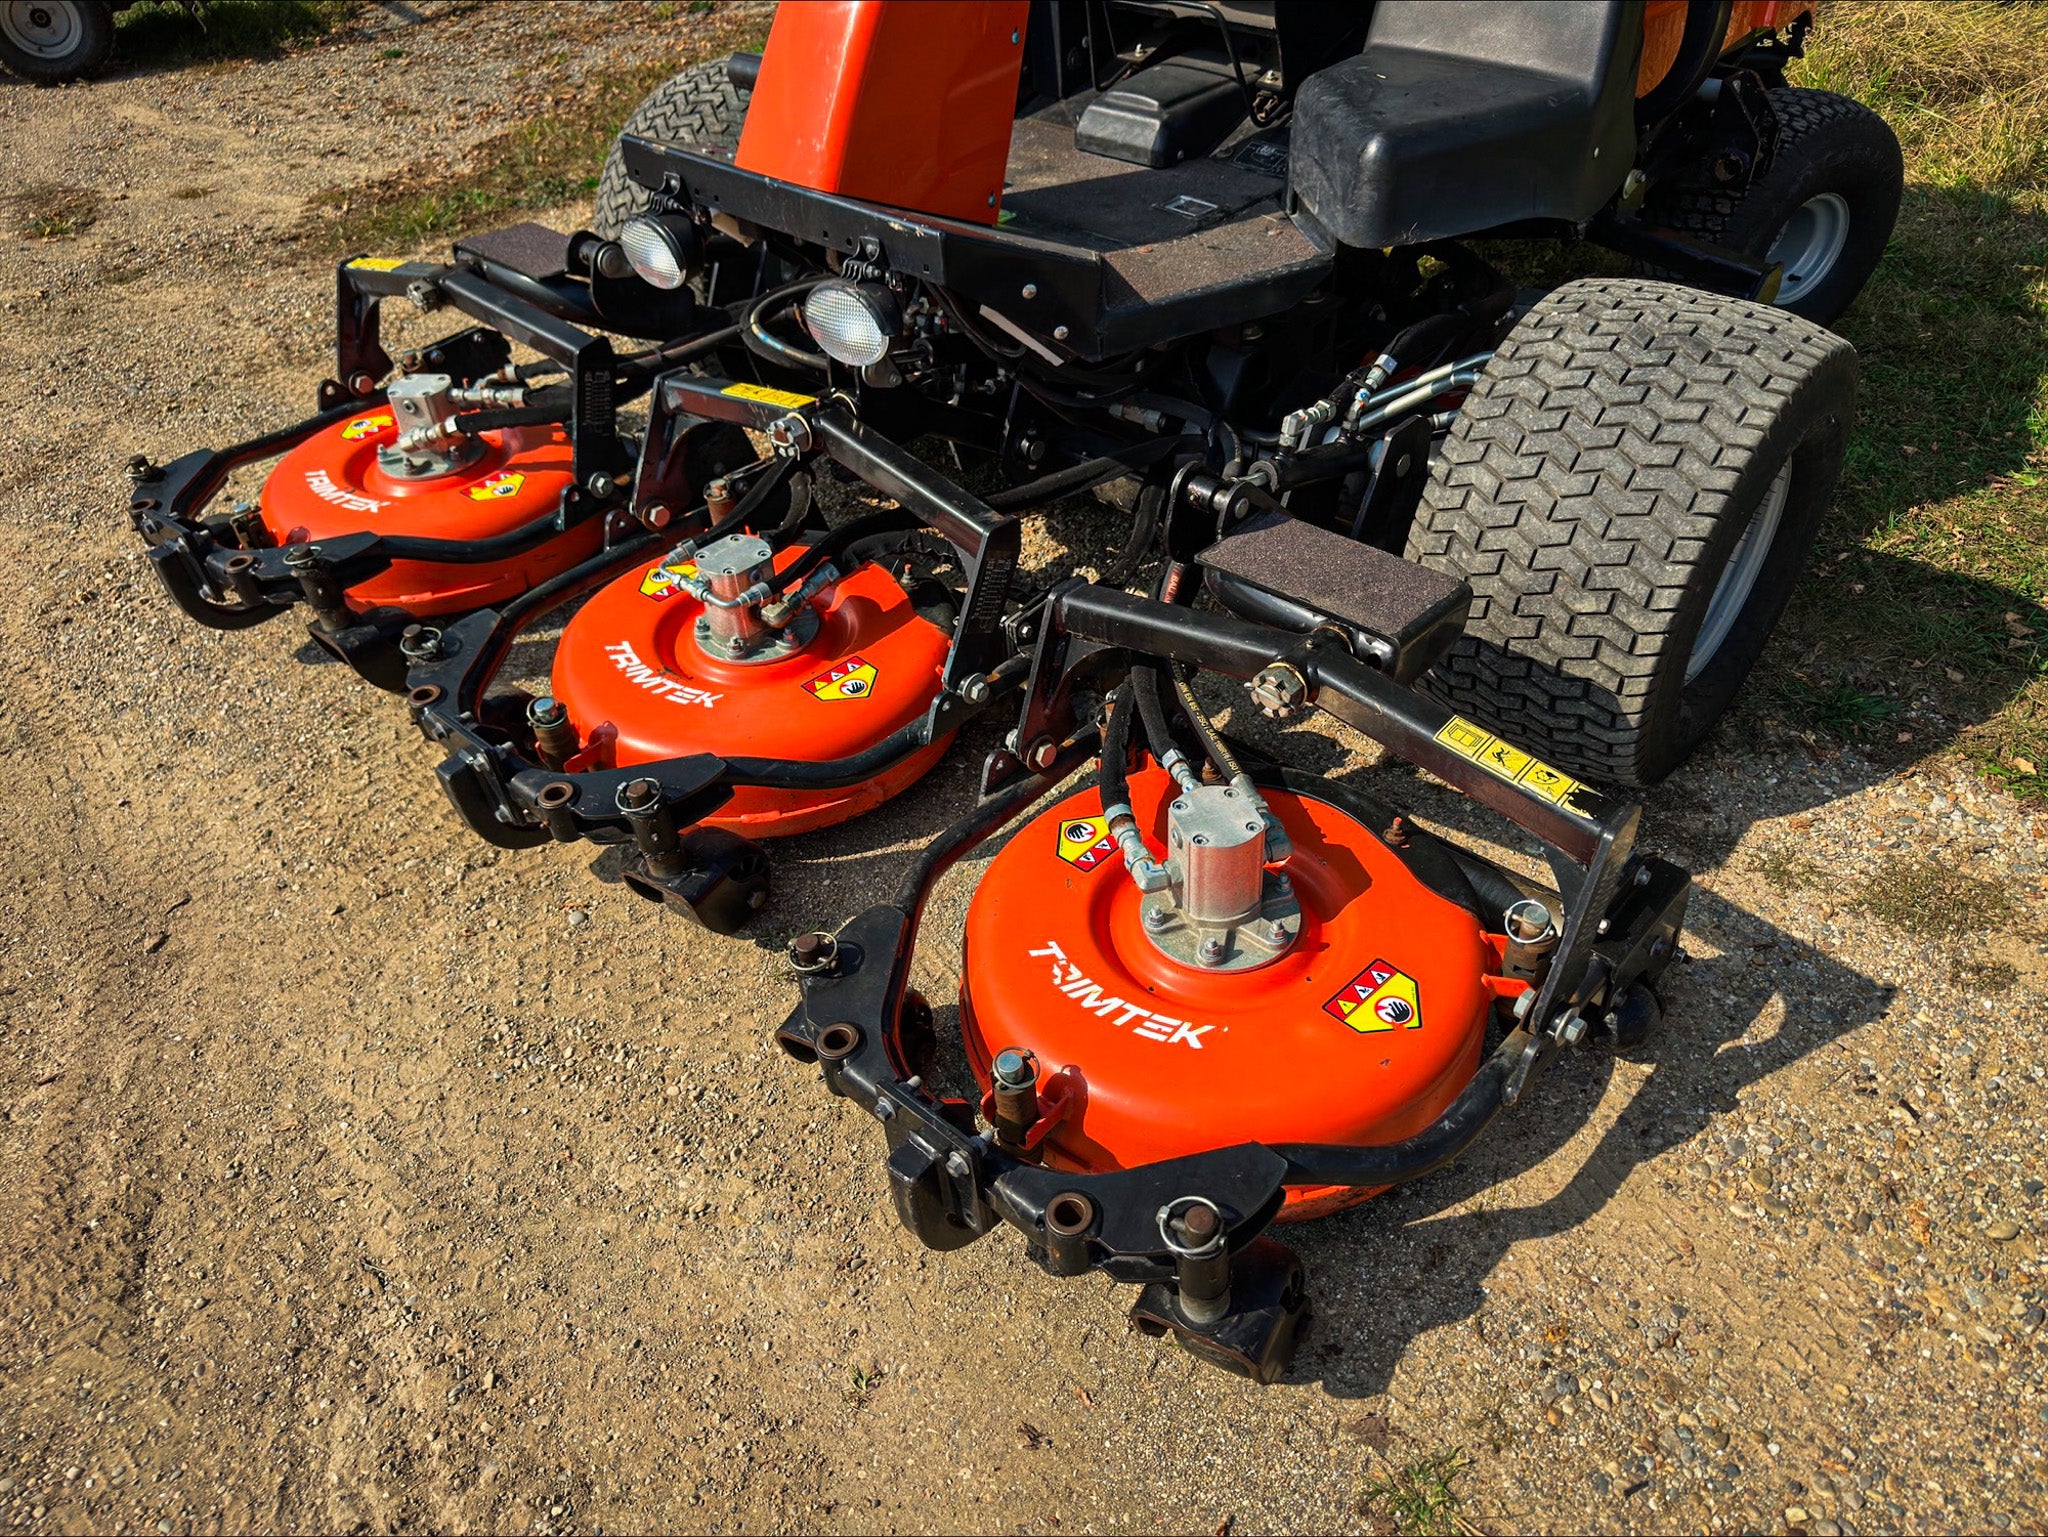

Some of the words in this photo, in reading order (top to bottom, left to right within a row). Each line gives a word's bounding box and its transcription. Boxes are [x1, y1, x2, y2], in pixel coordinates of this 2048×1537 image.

[304, 469, 392, 513] TRIMTEK
[604, 640, 724, 708] TRIMTEK
[1028, 940, 1216, 1050] TRIMTEK
